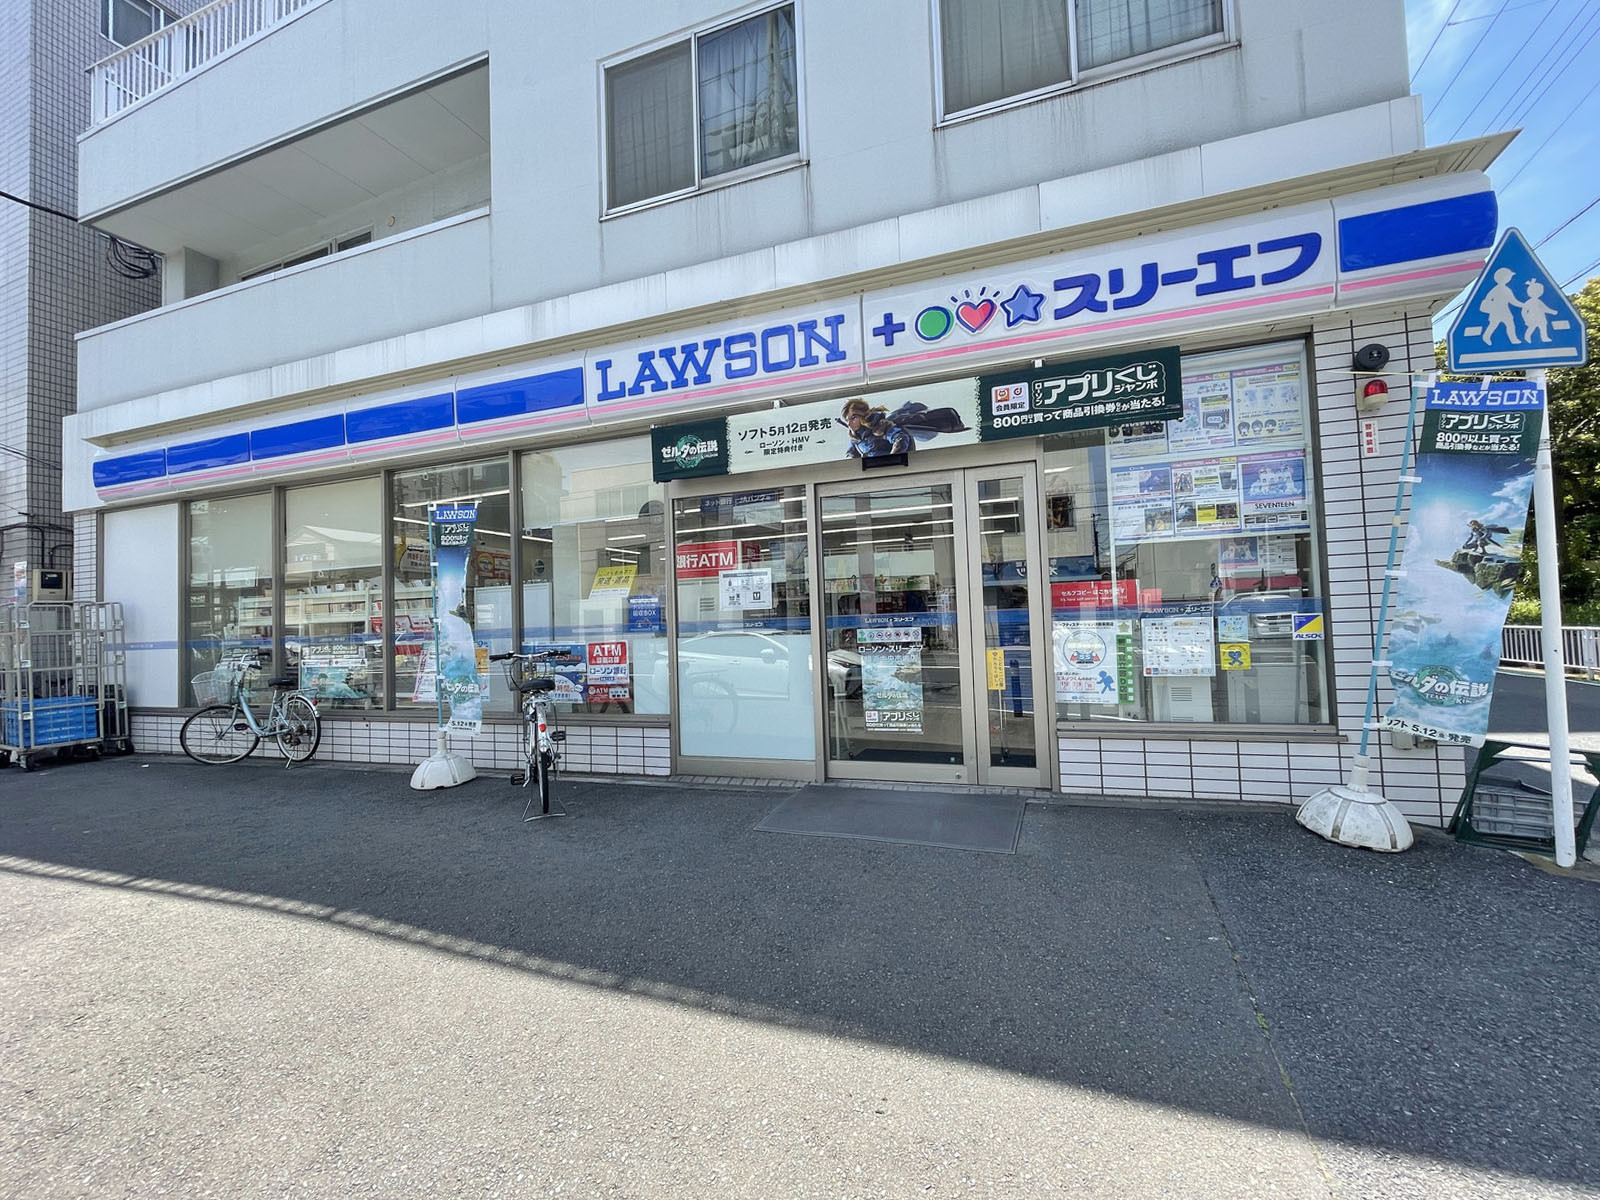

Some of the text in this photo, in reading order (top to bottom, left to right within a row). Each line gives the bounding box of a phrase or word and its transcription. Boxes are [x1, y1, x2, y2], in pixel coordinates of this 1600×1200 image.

[595, 314, 847, 402] LAWSON
[1053, 232, 1323, 321] スリーエフ
[1044, 364, 1158, 405] アプリくじ
[1114, 378, 1159, 395] ジャンボ
[1430, 388, 1540, 407] LAWSON
[995, 401, 1026, 413] 会員限定
[737, 416, 832, 441] ソフト5月12日発売
[1445, 413, 1521, 430] アプリくじ
[759, 435, 811, 449] ローソン・HMV
[1435, 432, 1522, 444] 800円以上買って
[661, 438, 719, 460] ゼルダの伝説
[1254, 501, 1296, 510] SEVENTEEN
[435, 510, 476, 520] LAWSON
[593, 644, 622, 657] ATM
